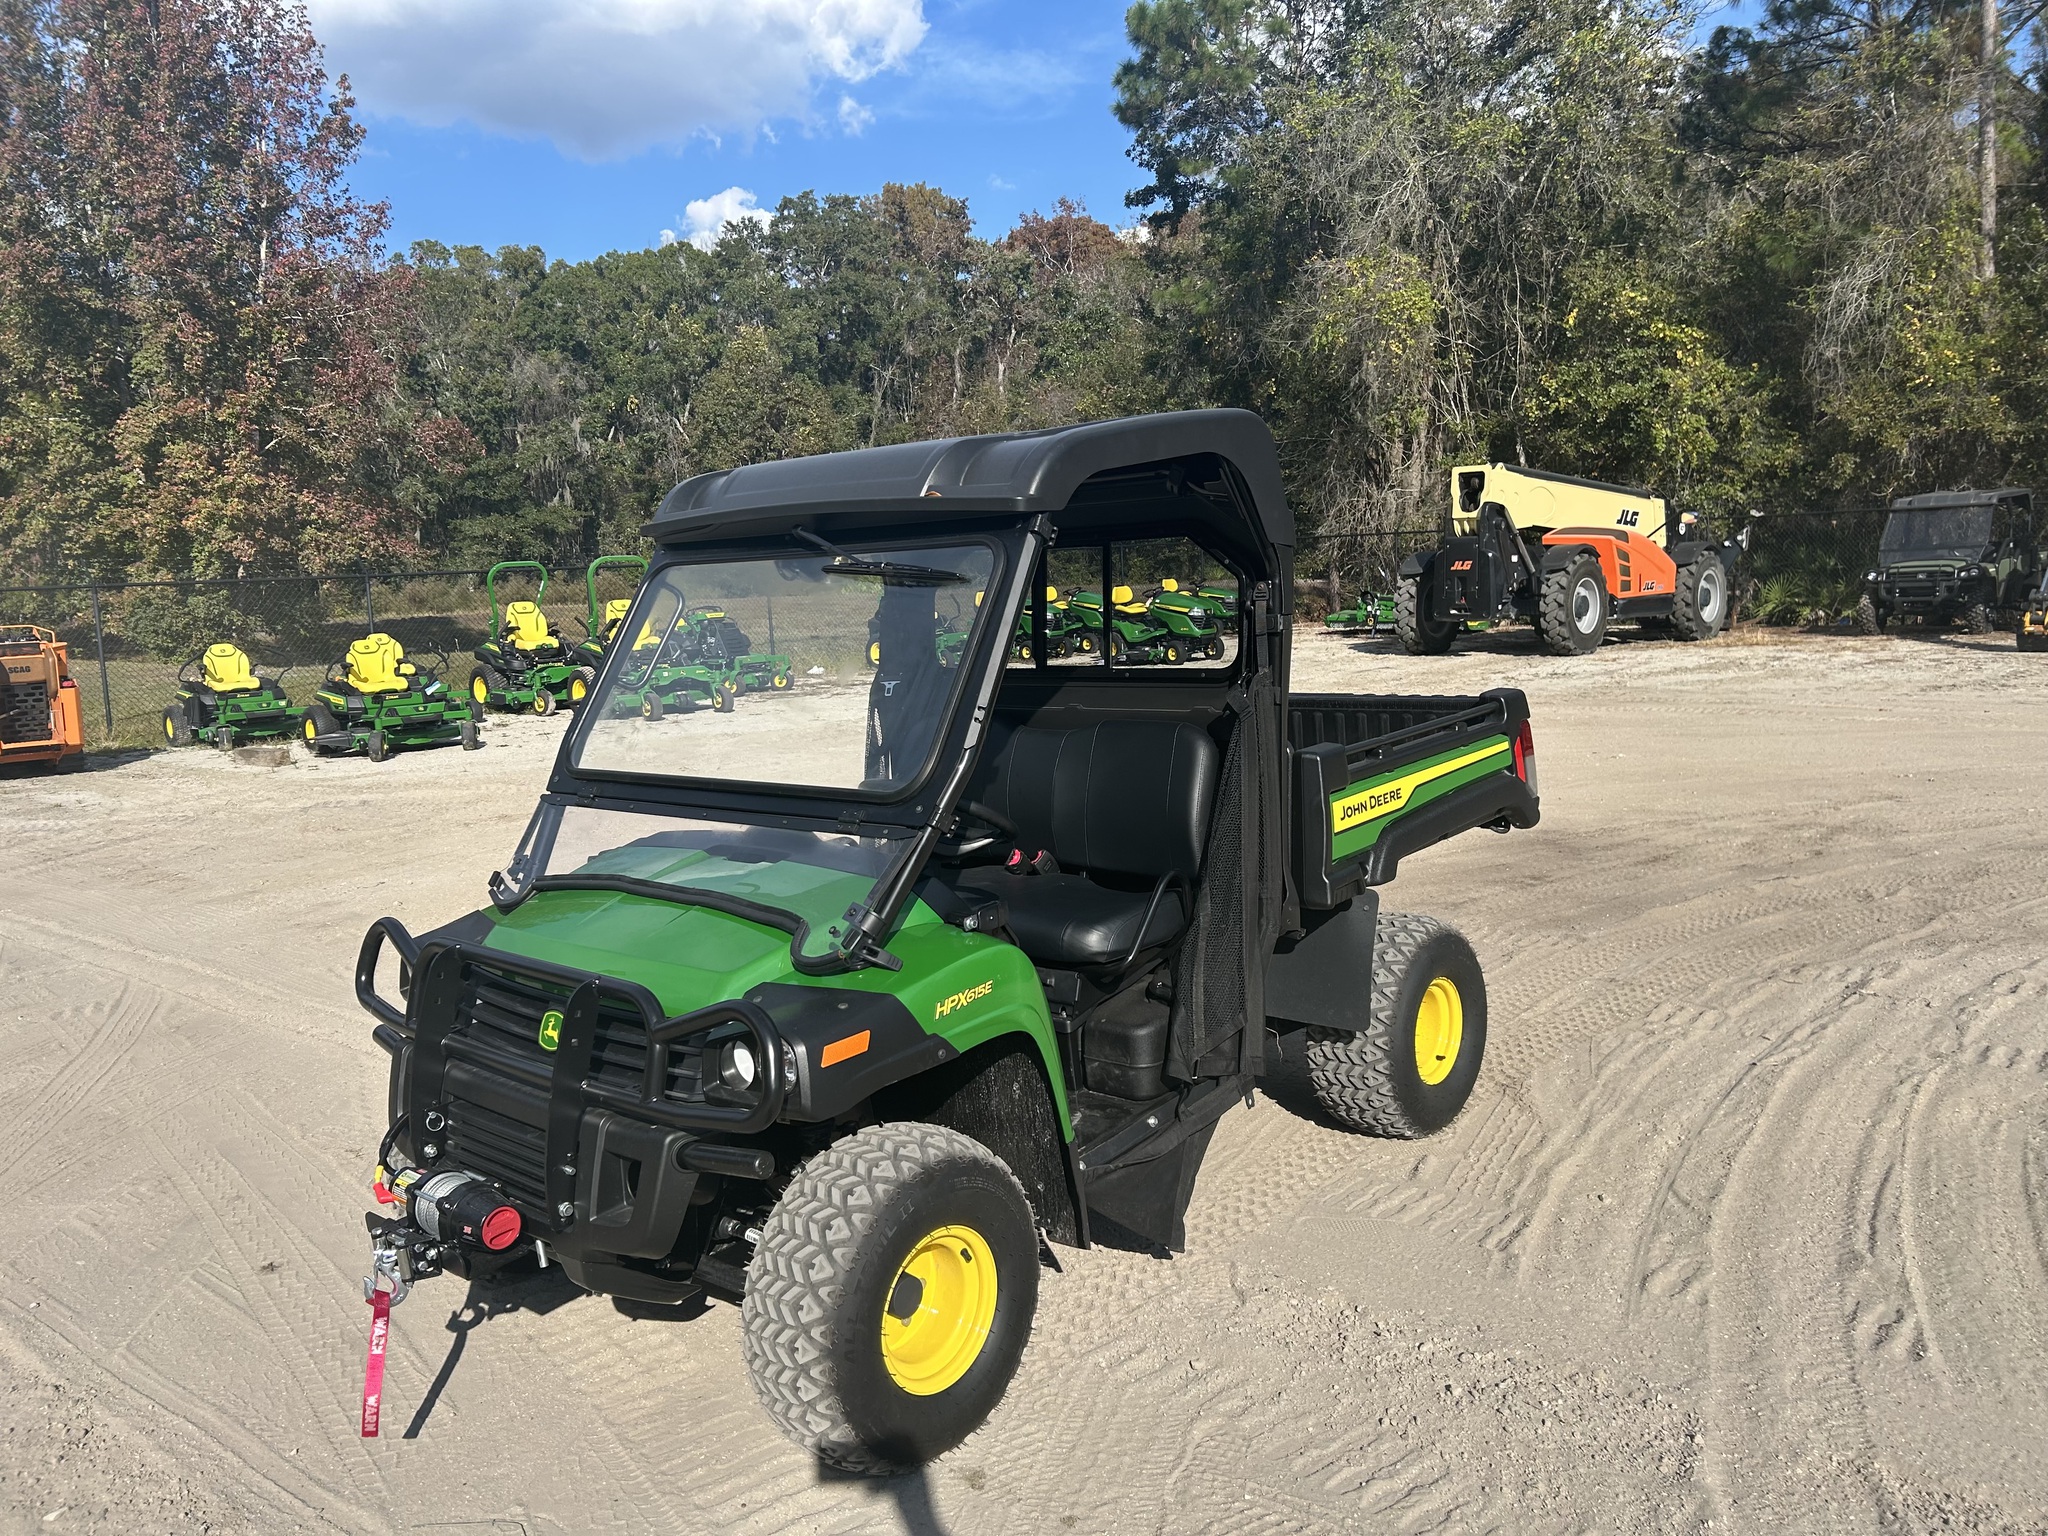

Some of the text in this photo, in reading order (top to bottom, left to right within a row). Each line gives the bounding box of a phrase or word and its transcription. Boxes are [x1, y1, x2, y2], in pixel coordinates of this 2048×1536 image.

[1616, 509, 1640, 527] JLG
[1450, 560, 1473, 570] JLG
[1642, 581, 1655, 591] JLG
[7, 665, 31, 674] SCAG
[1340, 787, 1402, 821] JOHN DEERE
[934, 979, 993, 1020] HPX615E
[364, 1393, 379, 1432] WARN
